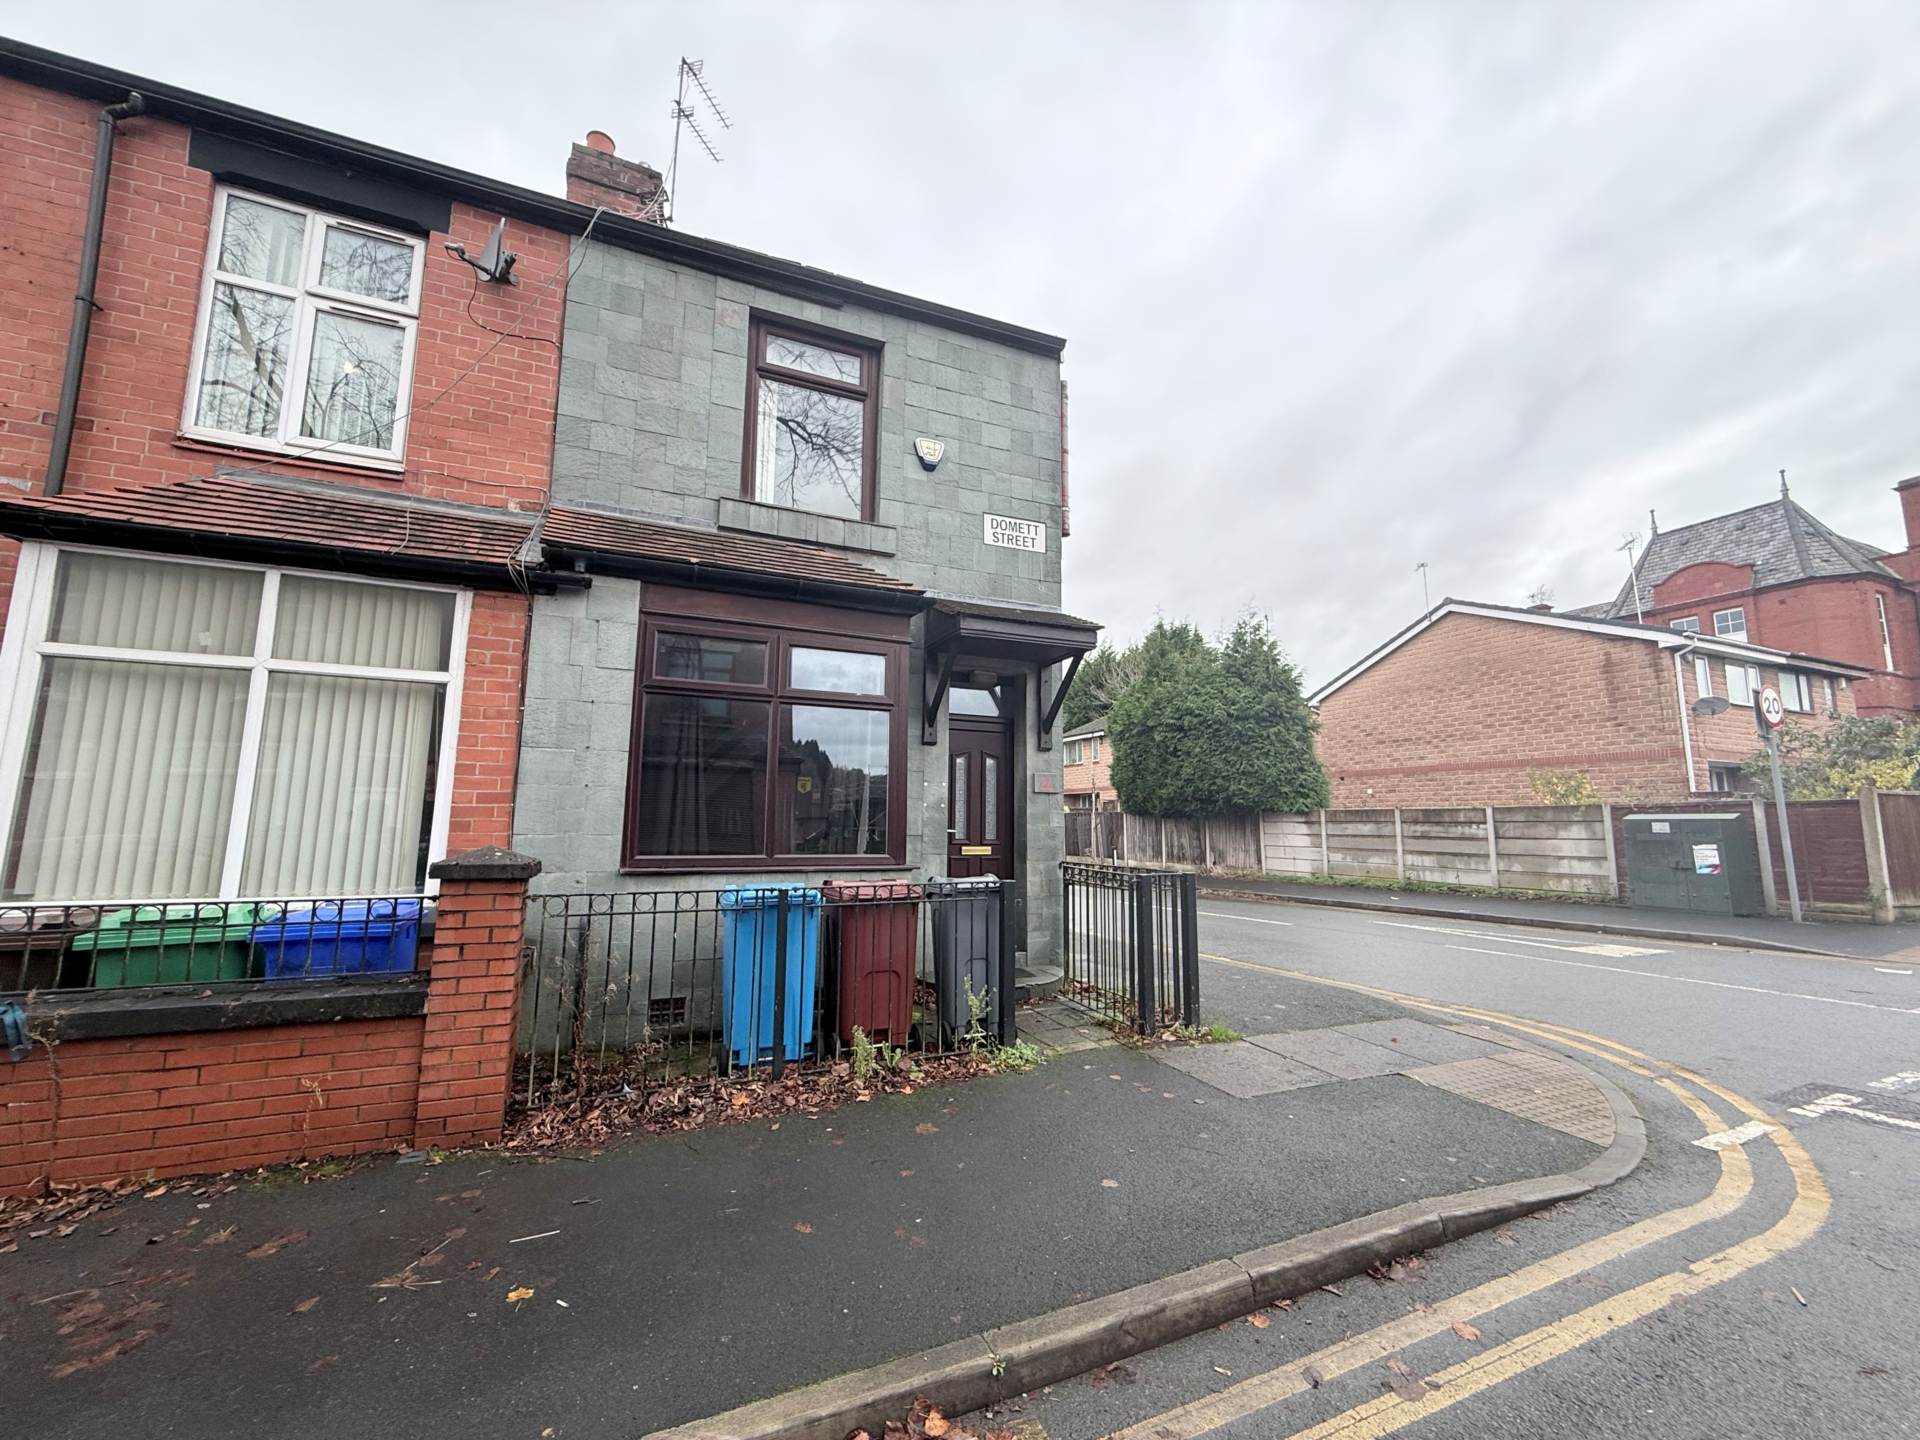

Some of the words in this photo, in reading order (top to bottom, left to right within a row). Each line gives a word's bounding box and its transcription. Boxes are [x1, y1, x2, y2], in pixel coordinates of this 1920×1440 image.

[990, 517, 1040, 537] DOMETT
[992, 531, 1038, 549] STREET
[1763, 696, 1780, 715] 20
